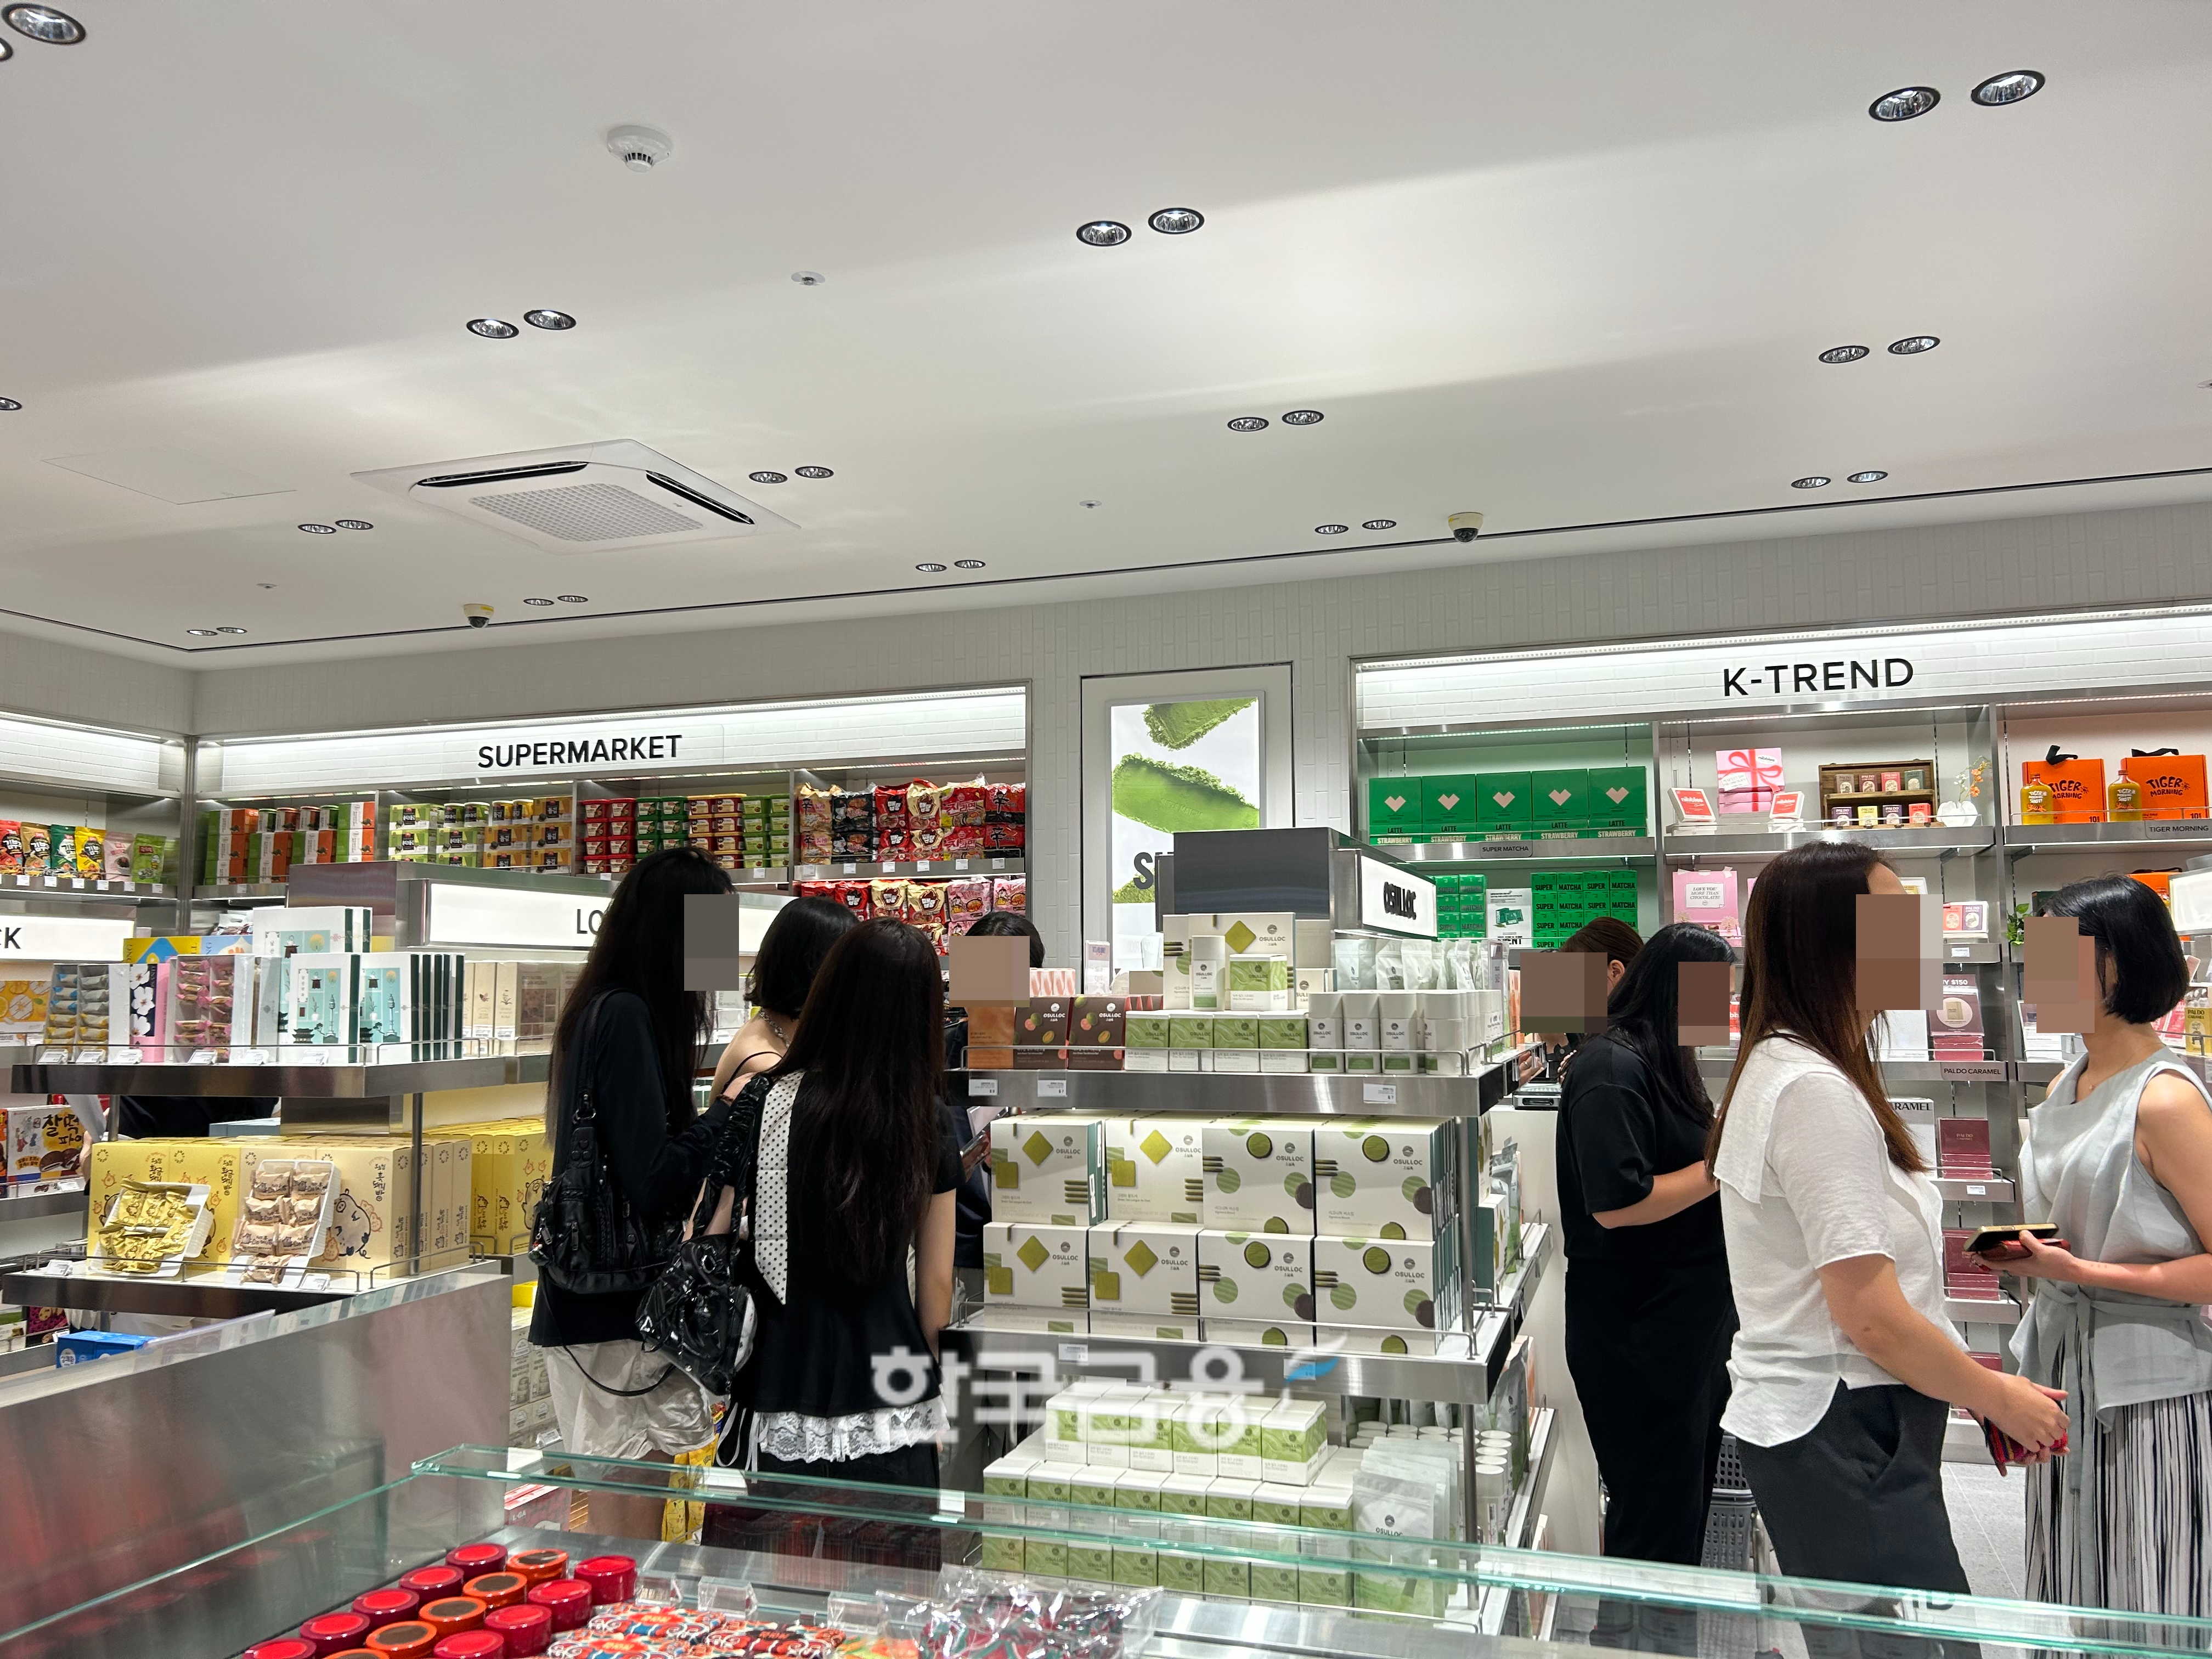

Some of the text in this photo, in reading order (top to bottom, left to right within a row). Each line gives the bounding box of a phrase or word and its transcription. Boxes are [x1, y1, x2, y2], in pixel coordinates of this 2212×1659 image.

[1724, 658, 1914, 697] K-TREND
[478, 735, 682, 768] SUPERMARKET
[2146, 776, 2182, 789] TIGER
[2150, 789, 2183, 797] MORNING
[946, 799, 978, 815] 진라면
[1161, 798, 1203, 818] SUPER MATCHA
[1485, 833, 1522, 841] STRAWBERRY
[1598, 830, 1636, 838] STRAWBERRY
[945, 837, 978, 851] 진라면
[1384, 882, 1417, 920] OSULLOC
[0, 927, 21, 950] K
[1894, 1102, 1933, 1111] RAMEL
[42, 1114, 80, 1137] 찰떡
[1393, 1158, 1424, 1166] OSULLOC
[1395, 1271, 1425, 1279] OSULLOC
[1375, 1527, 1403, 1537] OSULLOC
